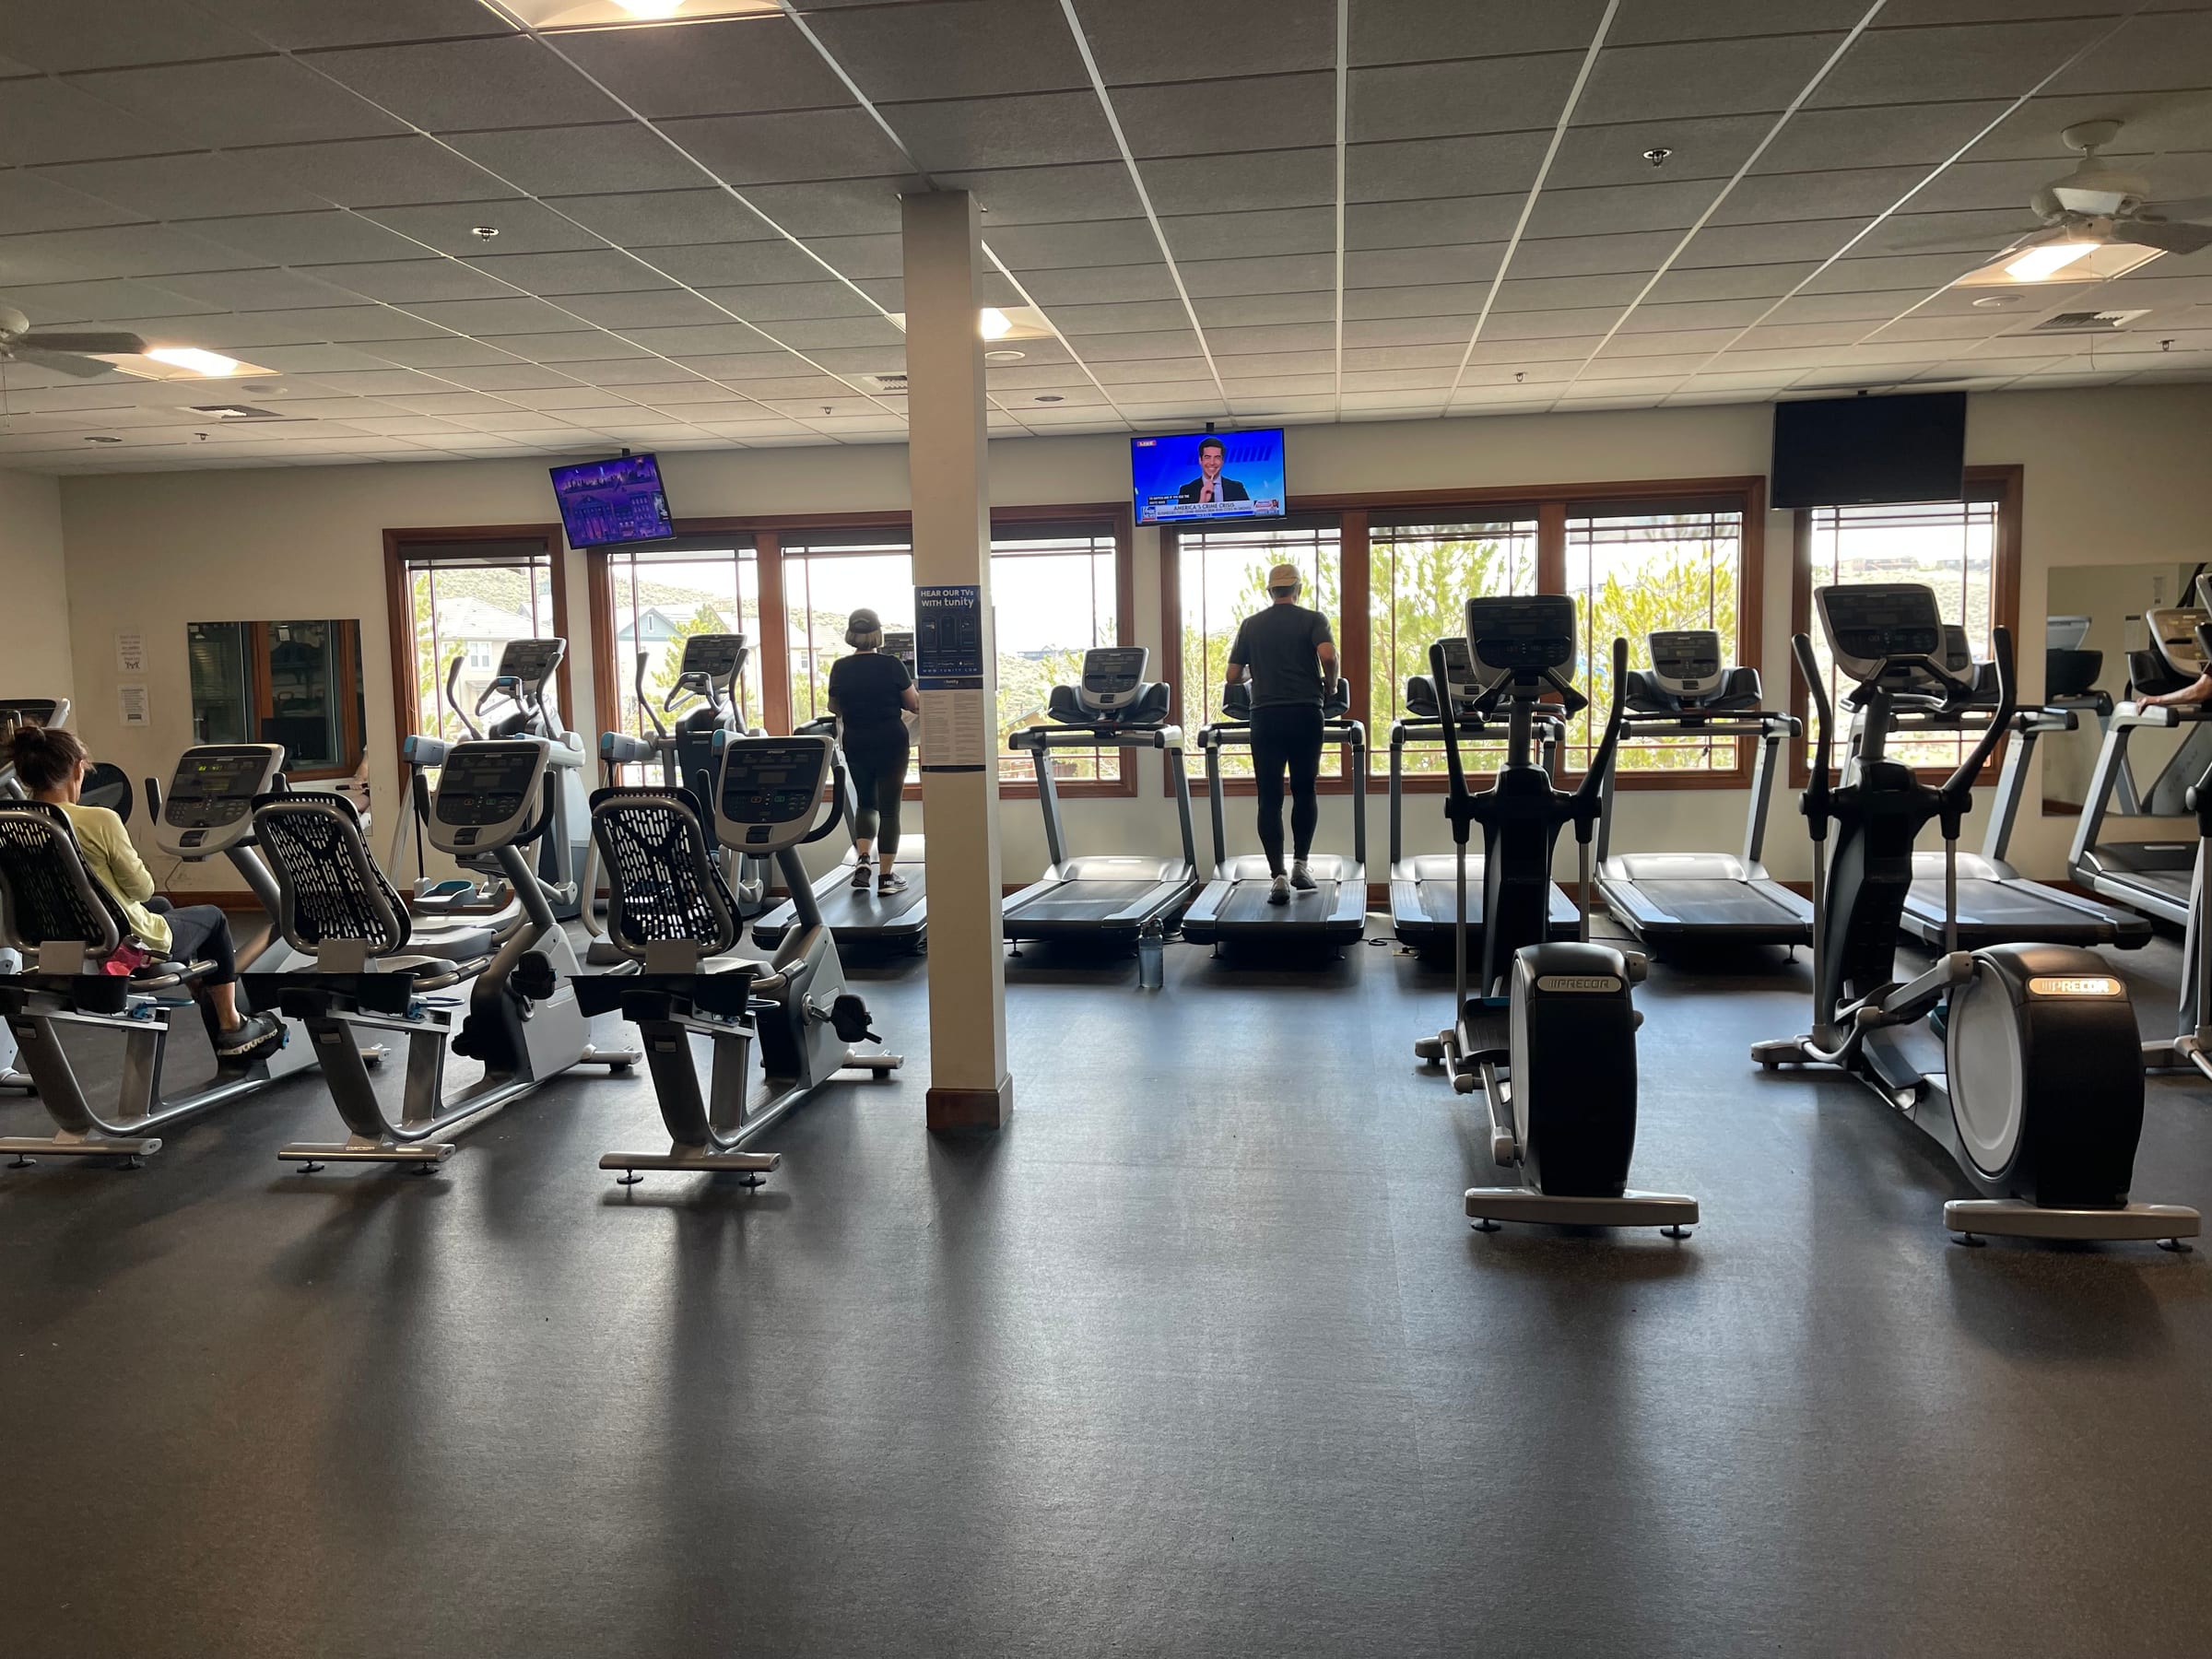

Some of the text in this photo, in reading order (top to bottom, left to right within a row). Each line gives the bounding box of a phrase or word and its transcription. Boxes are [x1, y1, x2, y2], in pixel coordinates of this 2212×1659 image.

[922, 596, 974, 608] WITH tunity
[1556, 979, 1609, 989] PRECOR
[2052, 980, 2110, 993] PRECOR
